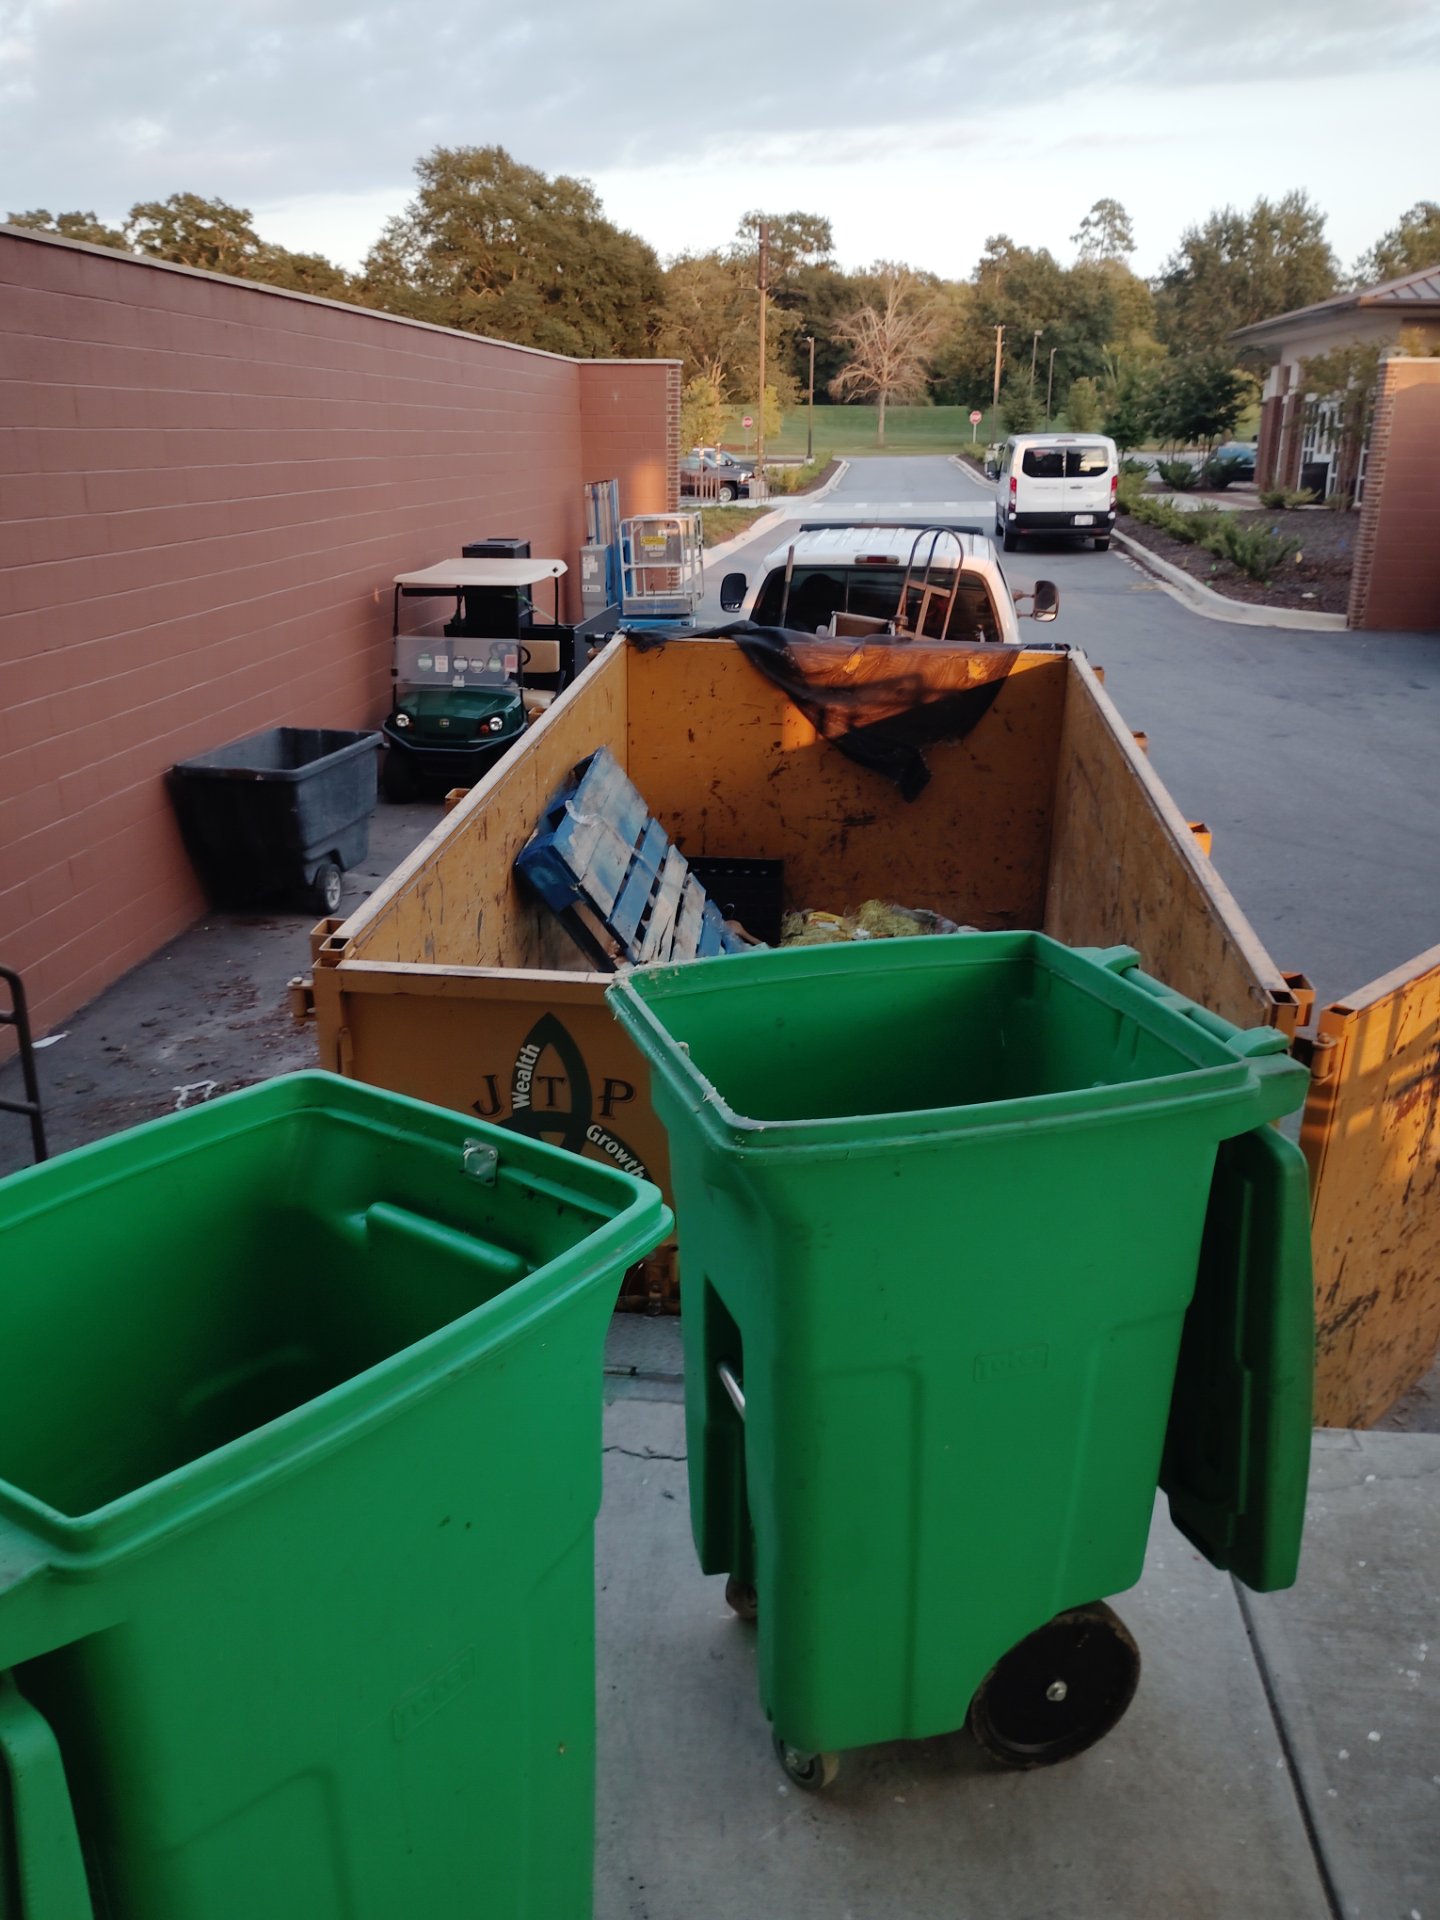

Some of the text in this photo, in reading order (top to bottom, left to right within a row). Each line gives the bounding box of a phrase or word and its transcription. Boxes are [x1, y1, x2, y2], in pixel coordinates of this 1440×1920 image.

[472, 1075, 636, 1119] J T P
[512, 1043, 540, 1110] Wealth
[586, 1124, 645, 1180] Growth
